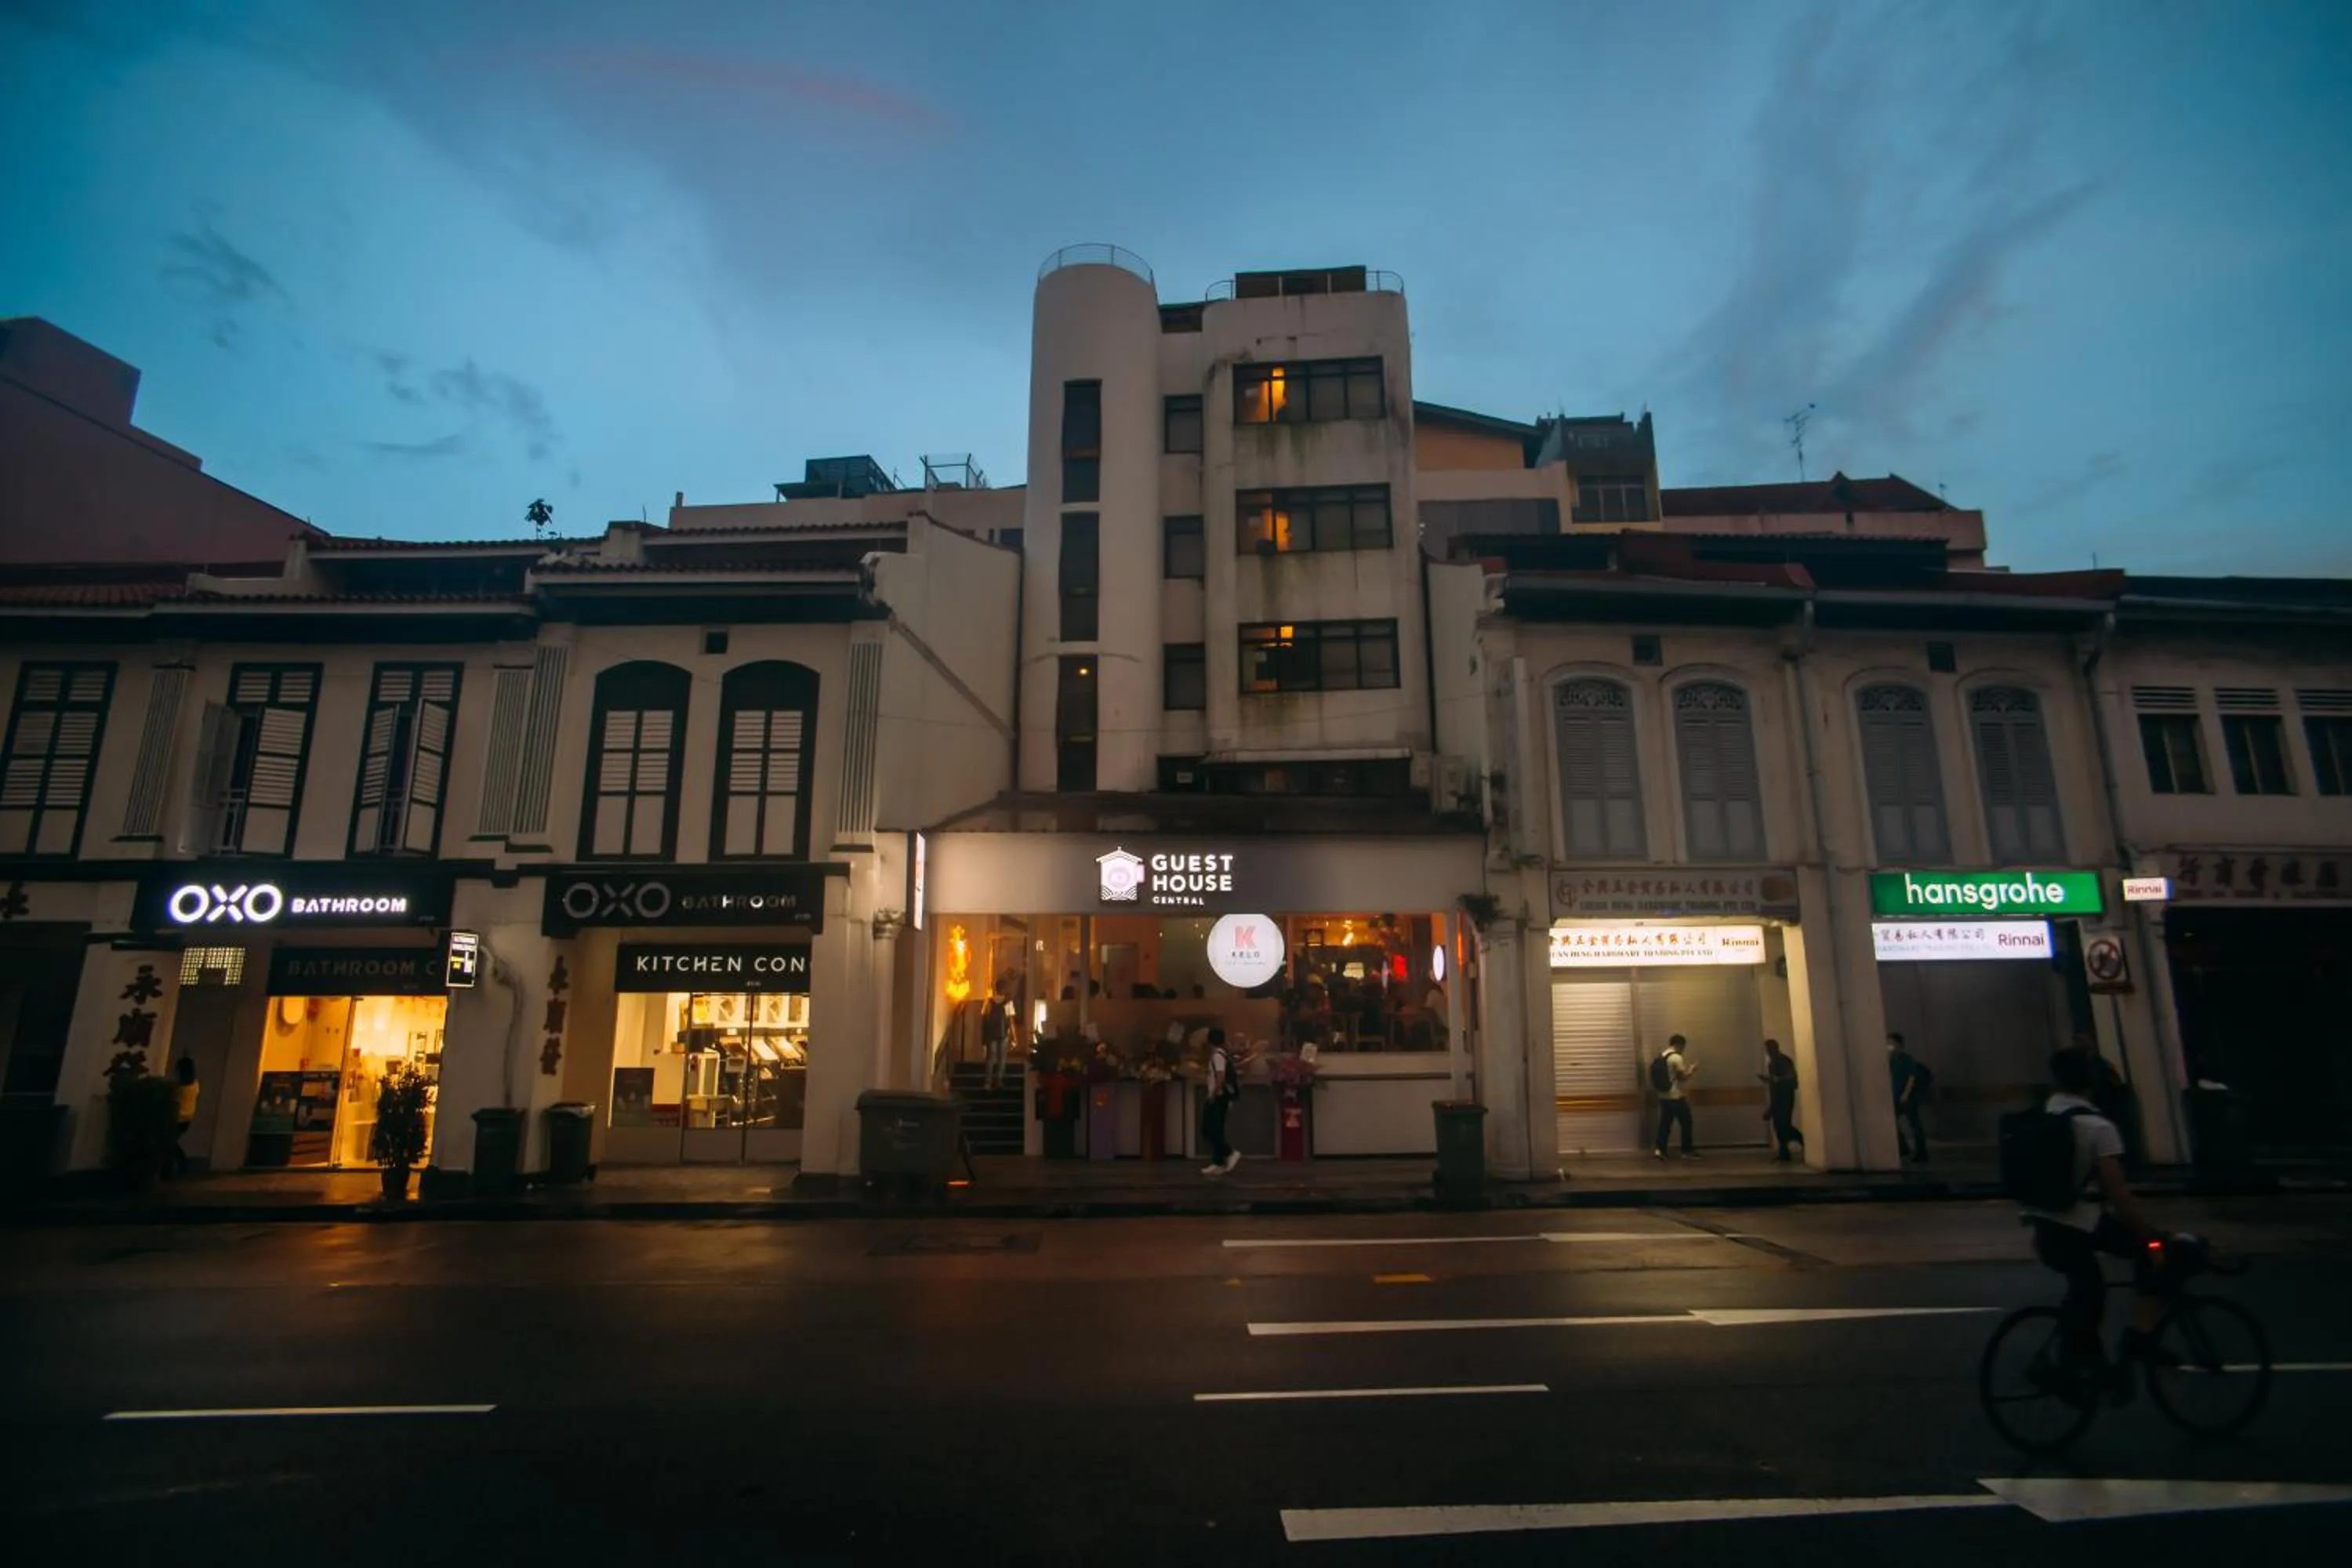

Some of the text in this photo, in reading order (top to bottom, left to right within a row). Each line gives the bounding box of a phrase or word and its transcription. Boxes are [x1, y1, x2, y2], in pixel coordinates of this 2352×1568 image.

[1152, 854, 1233, 872] GUEST
[1152, 874, 1233, 892] HOUSE
[1905, 871, 2064, 909] hansgrohe
[2127, 884, 2162, 894] Rinnai
[170, 884, 407, 923] OXO BATHROOM
[563, 882, 797, 918] OXO BATHROOM
[1152, 895, 1205, 906] CENTRAL
[1234, 926, 1256, 949] K
[1998, 932, 2045, 946] Rinnai
[288, 960, 416, 976] BATHROOM
[636, 956, 742, 972] KITCHEN
